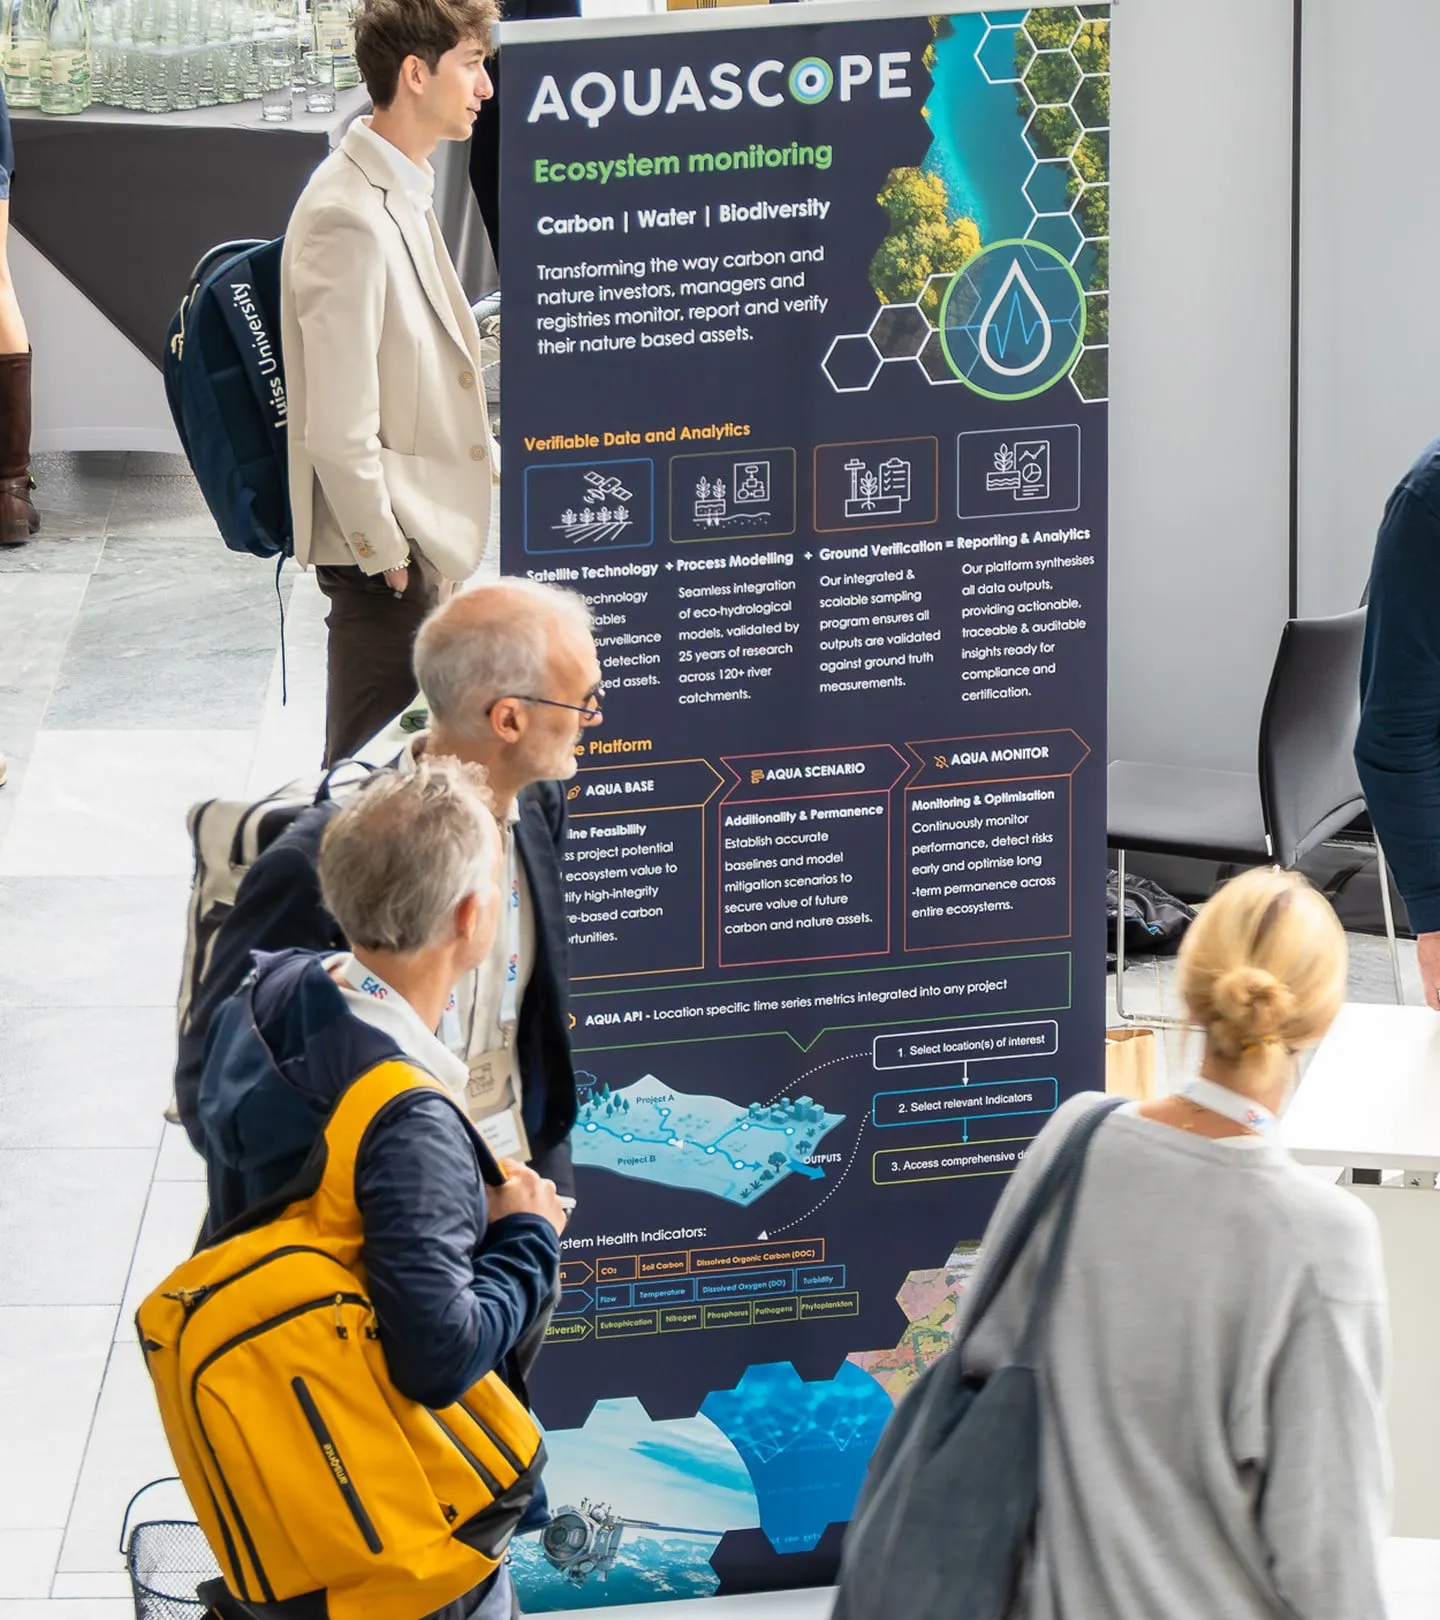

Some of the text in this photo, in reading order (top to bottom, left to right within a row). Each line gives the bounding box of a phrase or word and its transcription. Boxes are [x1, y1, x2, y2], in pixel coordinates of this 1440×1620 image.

[527, 51, 912, 127] AQUASCOPE
[535, 141, 832, 184] Ecosystem monitoring
[537, 197, 830, 235] Carbon Water Biodiversity
[536, 245, 824, 280] Transforming the way carbon and
[537, 271, 804, 305] nature investors, managers and
[537, 294, 828, 332] registries monitor, report and verify
[230, 282, 277, 375] University
[537, 325, 753, 354] their nature based assets.
[524, 422, 750, 451] Verifiable Data and Analytics
[957, 527, 1090, 550] Reporting & Analytics
[819, 539, 942, 560] Ground Verification
[676, 551, 793, 571] Process Modelling
[961, 554, 1094, 575] Our platform synthesises
[527, 562, 658, 582] Satellite Technology
[678, 579, 795, 598] Seamless integration
[961, 578, 1053, 596] all data outputs,
[678, 600, 792, 619] of eco-hydrological
[961, 597, 1081, 619] providing actionable,
[678, 621, 799, 640] models, validated by
[962, 618, 1086, 638] traceable & auditable
[678, 642, 793, 663] 25 years of research
[961, 641, 1055, 660] insights ready for
[678, 666, 772, 683] across 120+ river
[961, 662, 1056, 680] compliance and
[678, 688, 751, 704] catchments.
[961, 686, 1031, 701] certification.
[589, 738, 652, 754] Platform
[950, 746, 1048, 765] AQUA MONITOR
[766, 762, 865, 780] AQUA SCENARIO
[585, 779, 654, 796] AQUA BASE
[911, 789, 1054, 811] Monitoring & Optimisation
[724, 805, 884, 826] Additionality & Permanence
[911, 813, 1029, 833] Continuously monitor
[911, 832, 1053, 856] performance, detect risks
[911, 855, 1042, 875] early and optimise long
[912, 876, 1056, 897] -term permanence across
[911, 901, 1013, 918] entire ecosystems.
[585, 978, 1007, 1026] AQUA API Location specific time series metrics integrated into any project
[909, 1043, 940, 1055] Select
[943, 1038, 994, 1052] location(s)
[996, 1036, 1006, 1047] of
[1008, 1034, 1045, 1046] interest
[898, 1093, 1032, 1113] 2. Select relevant Indicators
[803, 1153, 841, 1164] OUTPUTS
[891, 1151, 1015, 1171] 3. Access comprehensive
[596, 1232, 638, 1246] Health
[641, 1227, 706, 1242] Indicators:
[696, 1249, 816, 1267] Dissolved Organic Carbon (DOC)
